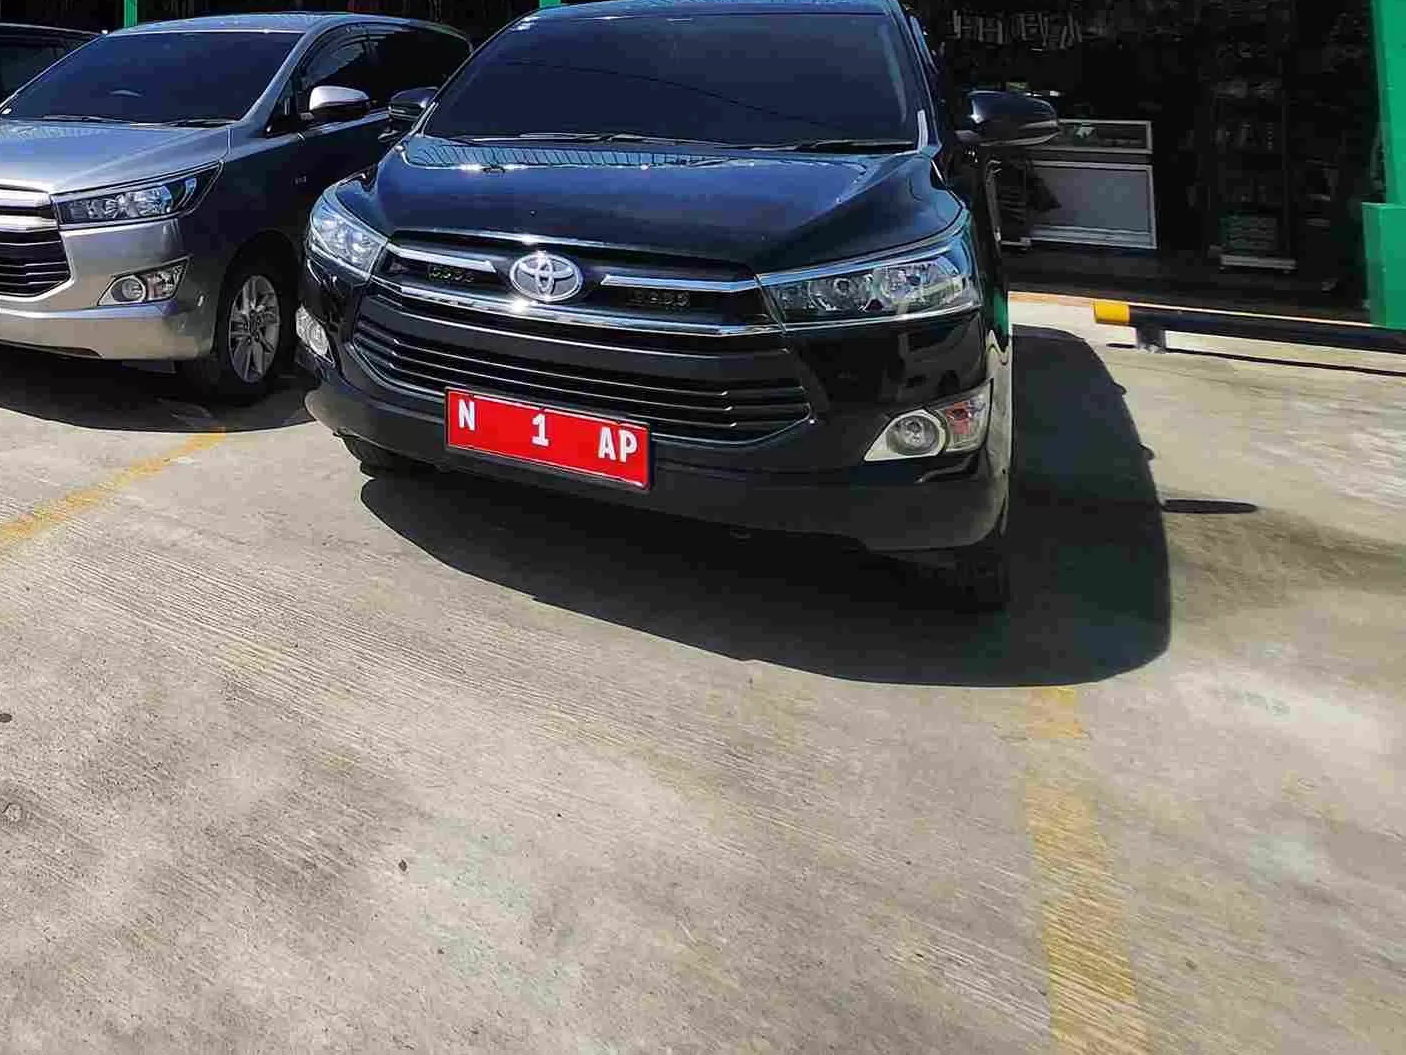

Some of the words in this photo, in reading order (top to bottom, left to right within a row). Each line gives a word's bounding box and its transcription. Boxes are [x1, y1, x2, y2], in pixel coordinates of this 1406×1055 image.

[457, 399, 476, 431] N
[531, 413, 550, 447] 1
[597, 426, 639, 463] AP
